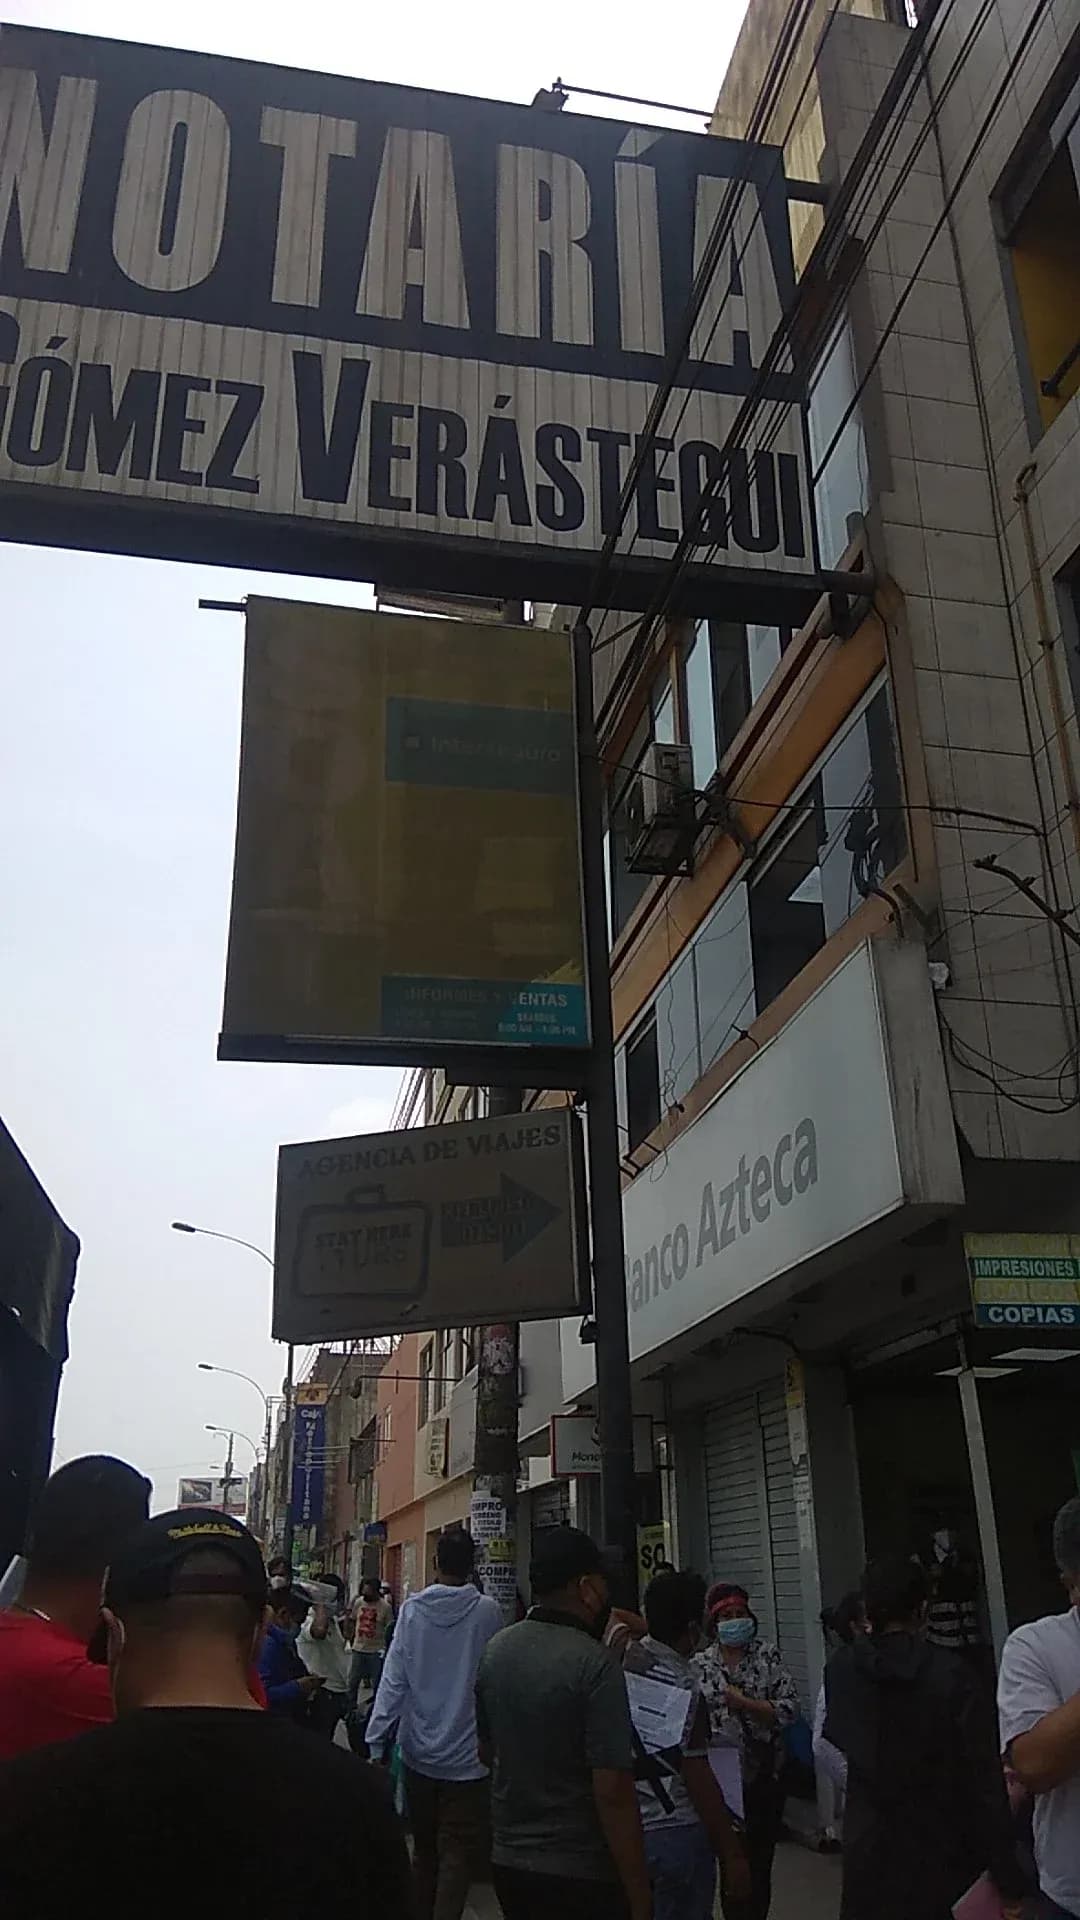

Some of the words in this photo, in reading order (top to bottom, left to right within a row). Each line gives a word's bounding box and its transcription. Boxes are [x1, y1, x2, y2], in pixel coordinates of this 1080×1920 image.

[0, 68, 797, 373] NOTARÍA
[291, 351, 805, 557] VERÁSTEGUI
[298, 1145, 417, 1179] AGENCIA
[424, 1138, 458, 1162] DE
[466, 1125, 562, 1157] VIAJES
[624, 1222, 689, 1313] anco
[696, 1117, 819, 1269] Azteca
[974, 1259, 1075, 1277] IMPRESIONES
[988, 1306, 1076, 1324] COPIAS
